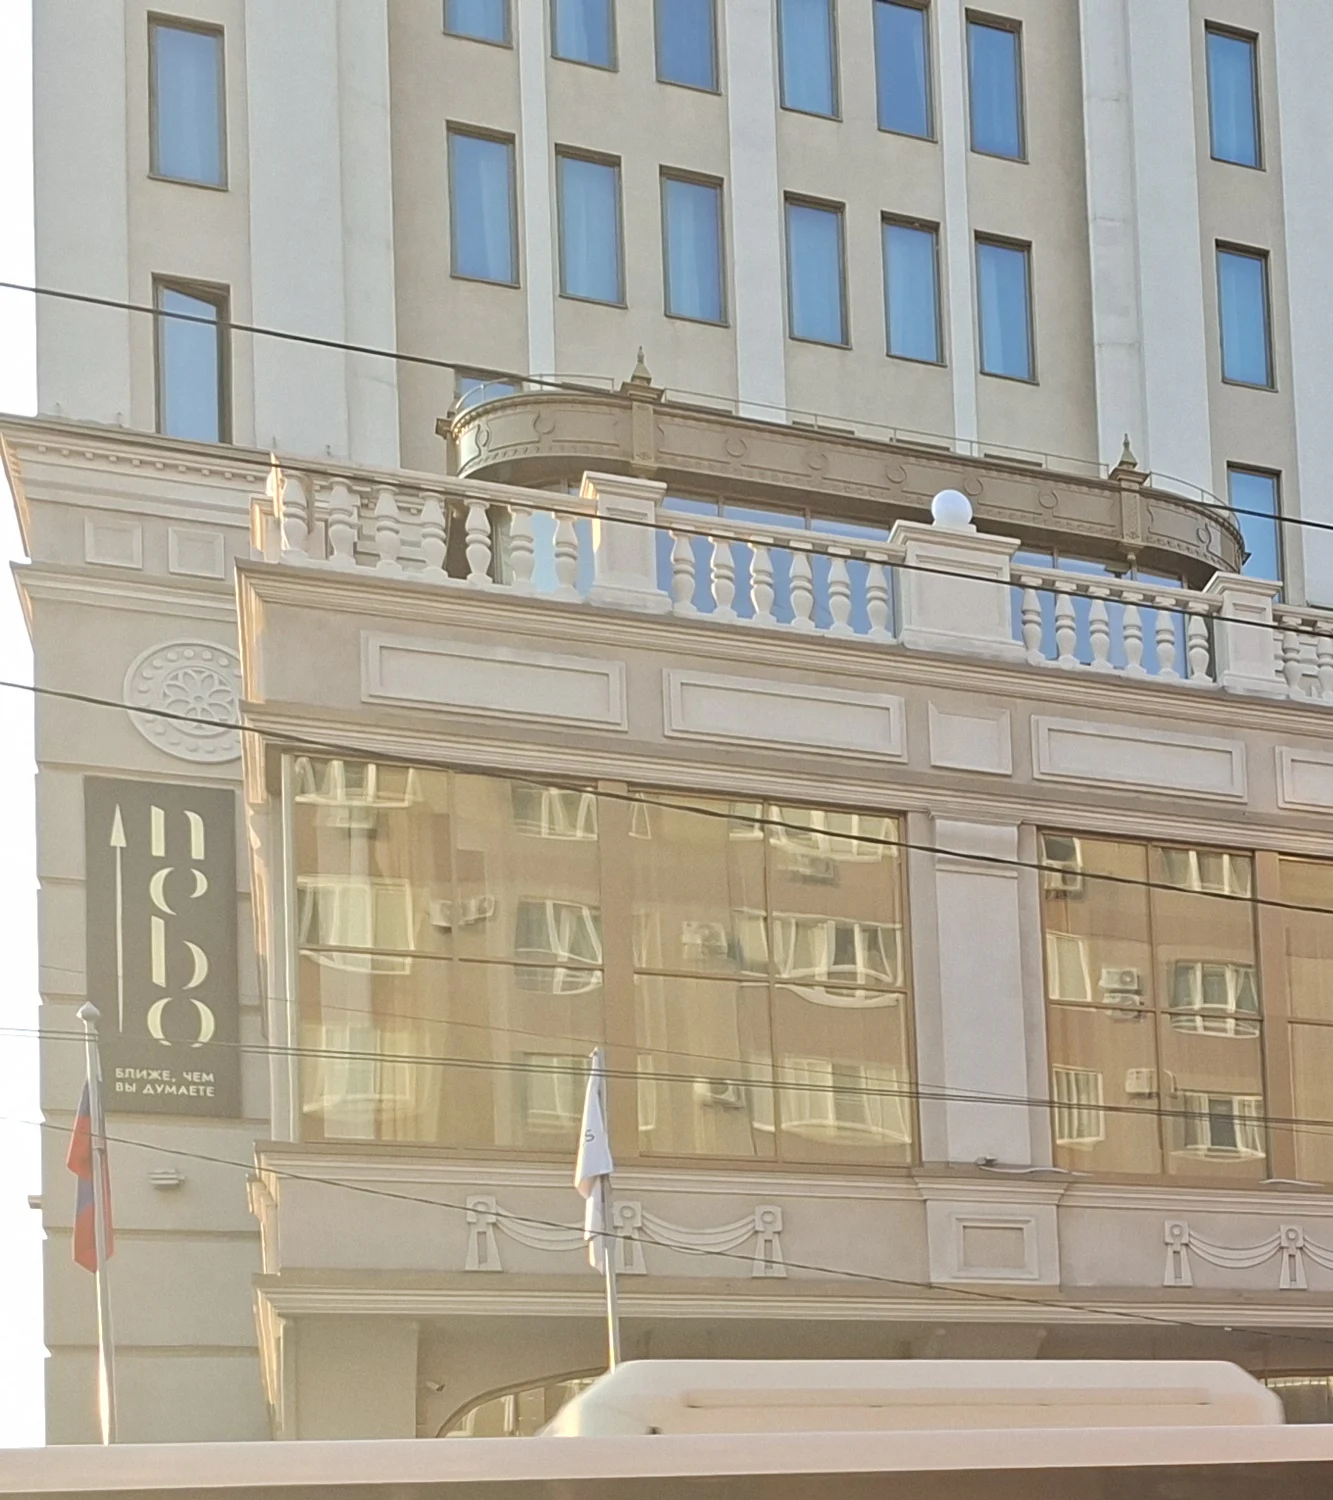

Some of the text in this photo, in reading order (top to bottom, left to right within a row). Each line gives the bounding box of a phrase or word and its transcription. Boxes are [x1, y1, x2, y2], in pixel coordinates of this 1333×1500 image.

[115, 1067, 215, 1083] БЛИЖЕ, ЧЕМ
[115, 1081, 215, 1097] ВЫ ДУМАЕТЕ
